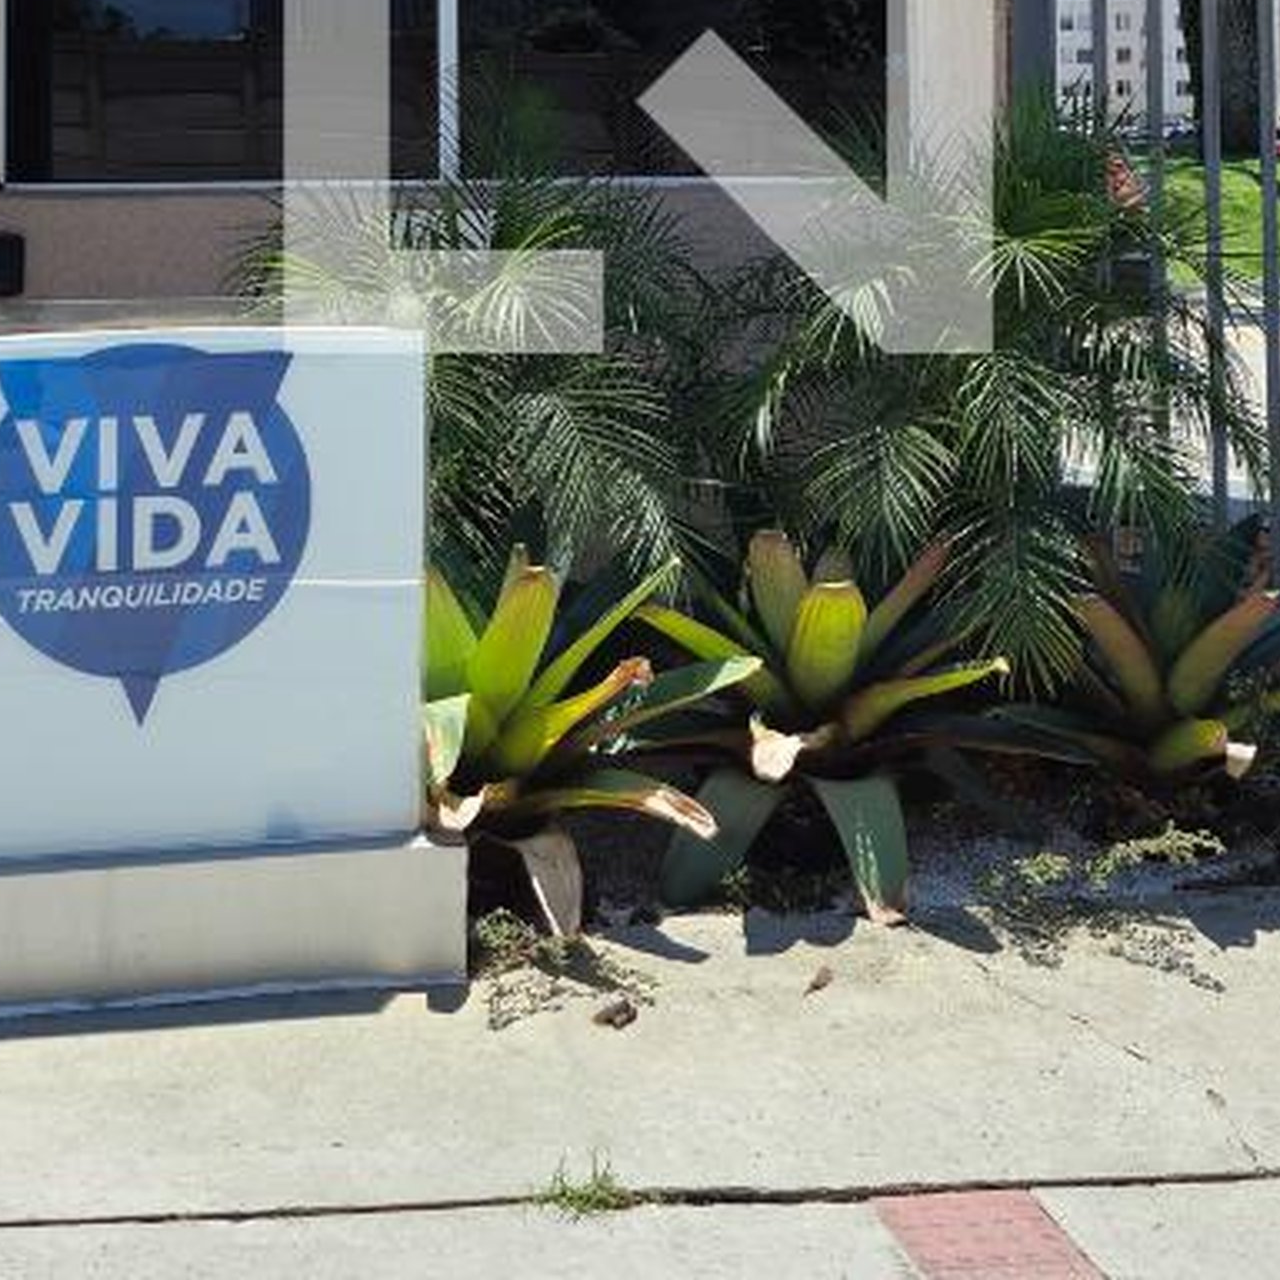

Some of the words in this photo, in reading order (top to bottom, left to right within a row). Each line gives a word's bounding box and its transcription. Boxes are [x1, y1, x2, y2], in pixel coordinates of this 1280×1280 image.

[16, 411, 278, 494] VIVA
[9, 491, 281, 574] VIDA
[18, 578, 267, 613] TRANQUILIDADE
